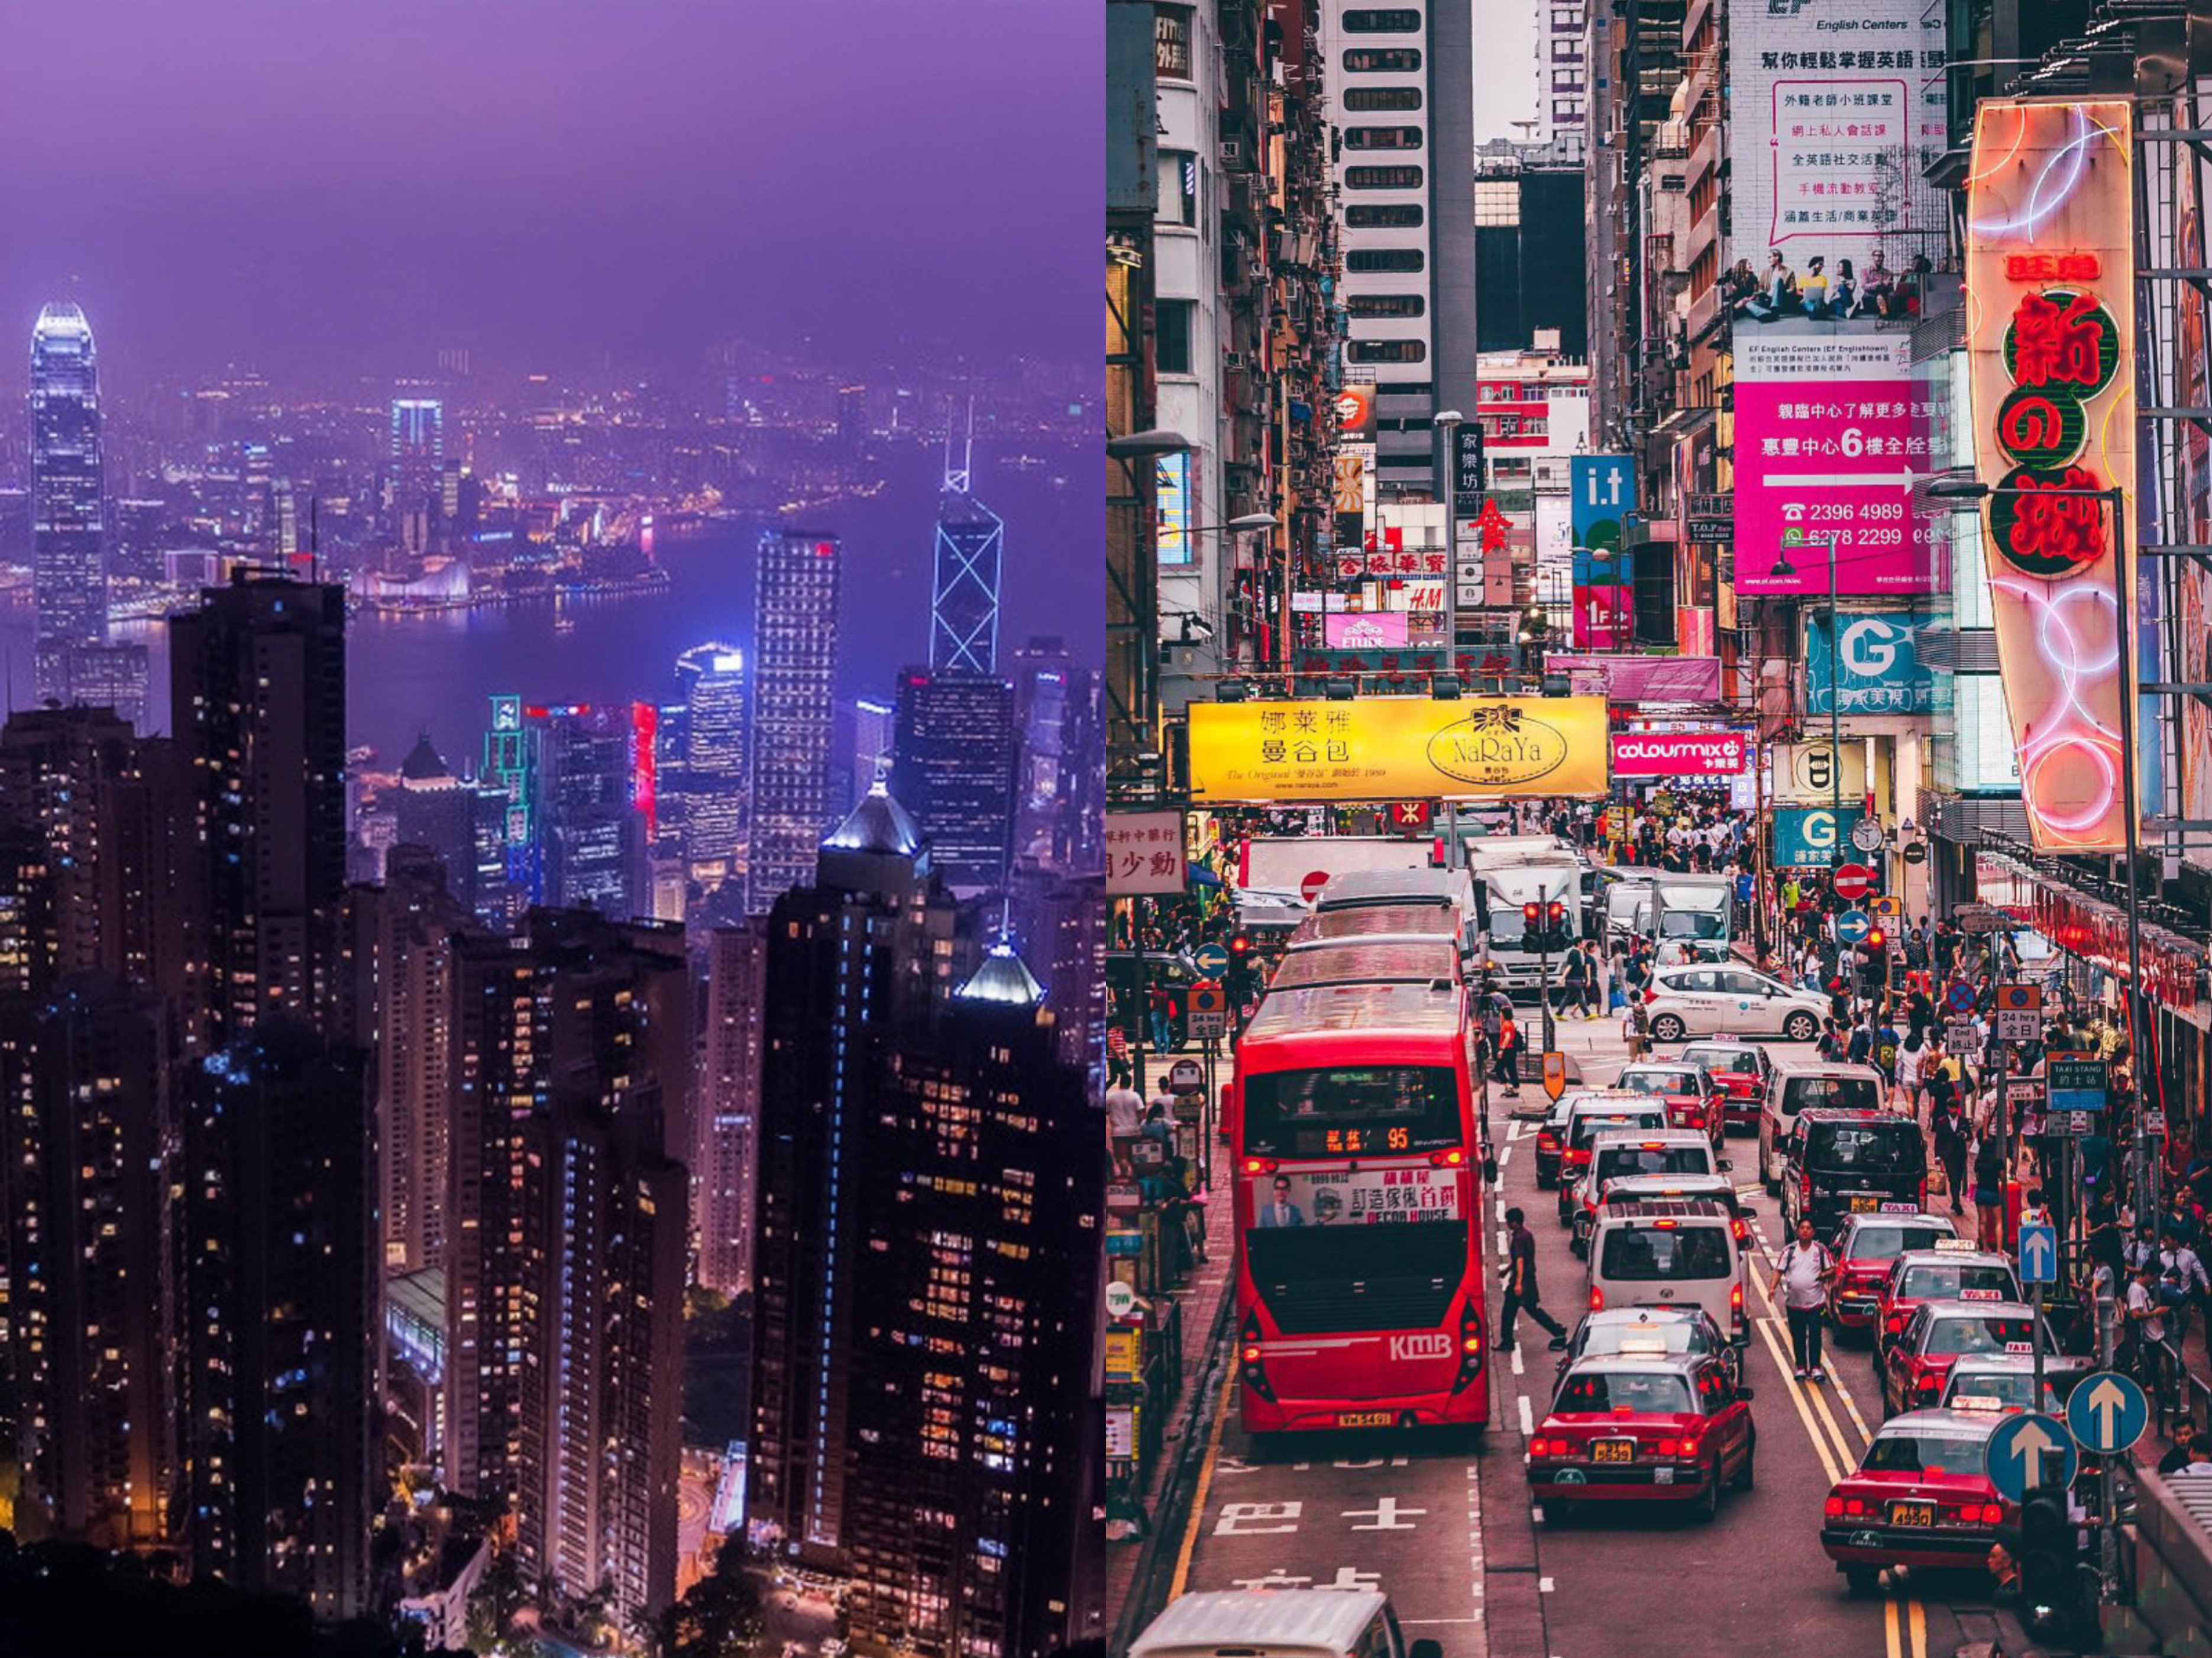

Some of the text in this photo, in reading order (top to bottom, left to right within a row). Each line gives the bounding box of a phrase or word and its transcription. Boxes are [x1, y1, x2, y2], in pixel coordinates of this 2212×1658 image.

[1817, 20, 1858, 33] English
[1862, 20, 1907, 30] Centers
[1761, 51, 1914, 69] 幫你輕鬆掌握英語
[1784, 93, 1893, 107] 外籍老師小班課堂
[1791, 124, 1887, 137] 網上私人會話課
[1799, 182, 1880, 195] 手機流動教室
[1761, 345, 1790, 354] English
[1778, 402, 1906, 419] 親臨中心了解更多
[1761, 428, 1912, 457] 惠豐中心6樓全
[1461, 433, 1477, 489] 家樂坊
[1589, 468, 1622, 505] i.t
[1810, 504, 1854, 520] 2396
[1859, 504, 1903, 520] 4989
[1809, 529, 1852, 545] 6278
[1858, 528, 1901, 545] 2299
[1341, 637, 1386, 648] ETUDE
[1841, 619, 1895, 676] G
[1261, 710, 1350, 735] 娜萊雅
[1262, 739, 1349, 763] 曼谷包
[1454, 737, 1542, 762] NaRaYa
[1618, 742, 1722, 758] colourmix
[1226, 770, 1243, 780] The
[1247, 768, 1291, 781] Original
[1803, 812, 1835, 847] G
[1207, 1014, 1222, 1023] hrs
[2002, 1013, 2036, 1022] 24 hrs
[1195, 1024, 1219, 1035] 全日
[2006, 1024, 2032, 1036] 全日
[1952, 1039, 1974, 1049] 終止
[2059, 1075, 2097, 1085] 的士站
[1388, 1127, 1408, 1150] 95
[1964, 1290, 2000, 1300] TAXI
[1390, 1334, 1453, 1360] KMB
[2008, 1344, 2032, 1352] TAXI
[1212, 1497, 1427, 1536] 巴士
